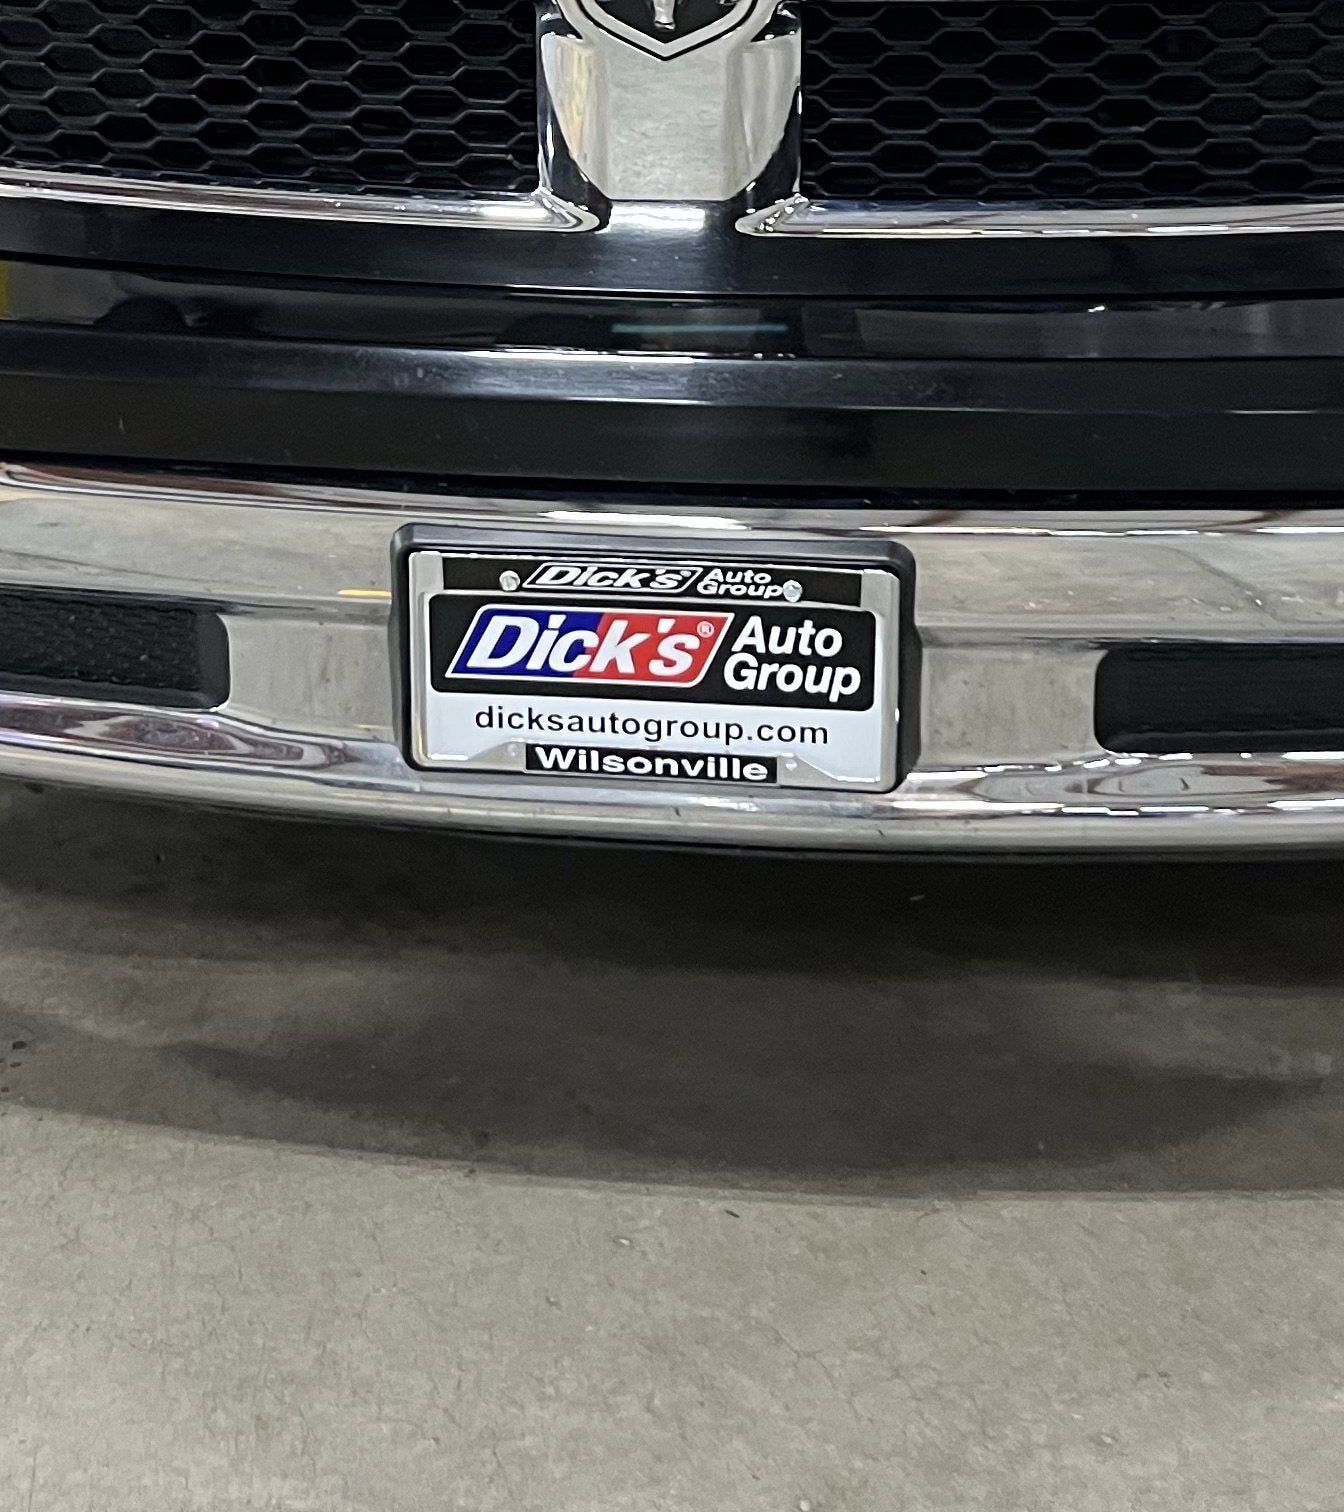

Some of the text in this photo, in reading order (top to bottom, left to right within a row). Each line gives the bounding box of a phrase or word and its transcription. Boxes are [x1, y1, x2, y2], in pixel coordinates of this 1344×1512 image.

[696, 580, 784, 599] Group
[704, 568, 772, 584] Auto
[466, 614, 843, 677] Dick's Auto
[723, 654, 862, 703] Group
[475, 705, 829, 745] dicksautogroup.com
[533, 745, 769, 781] Wilsonville
